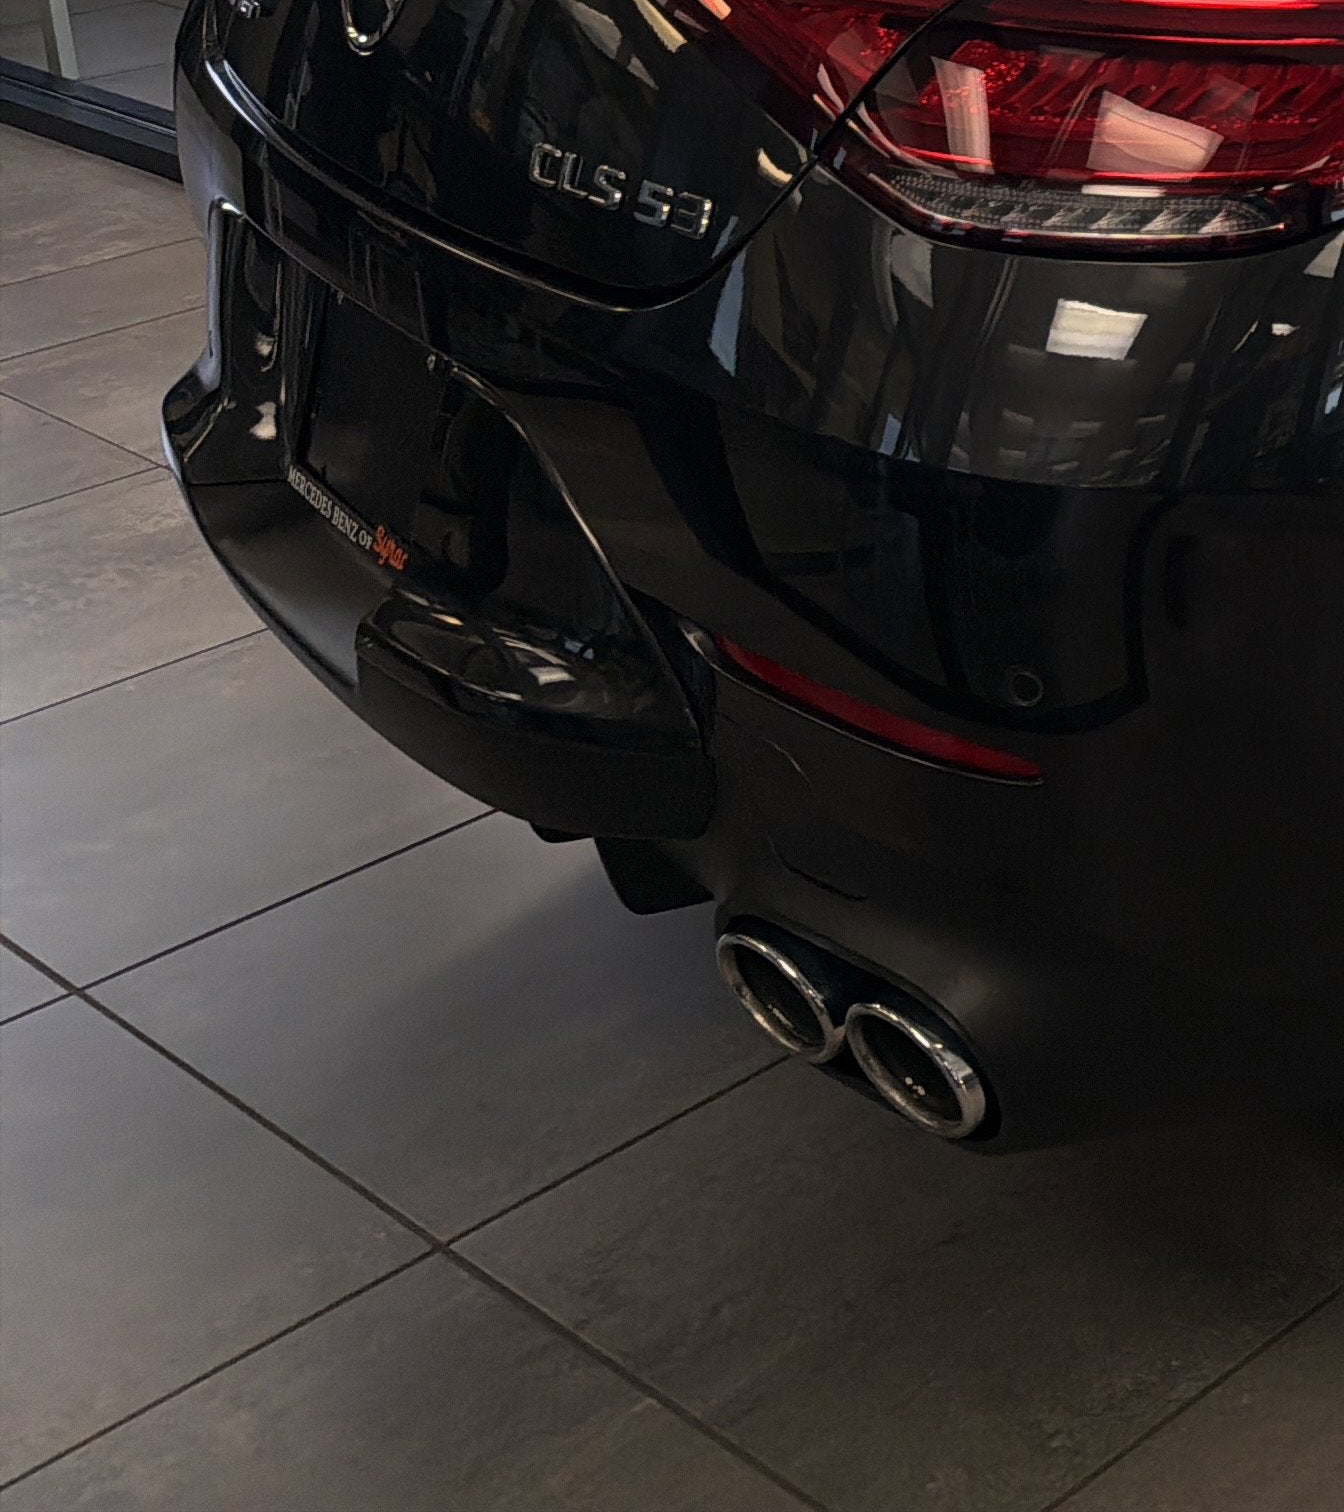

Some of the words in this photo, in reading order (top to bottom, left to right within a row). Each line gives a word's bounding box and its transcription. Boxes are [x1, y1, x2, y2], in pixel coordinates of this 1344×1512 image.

[530, 142, 626, 210] CLS
[633, 179, 713, 240] 53
[286, 465, 333, 519] MERCEDES
[331, 506, 358, 543] BENZ
